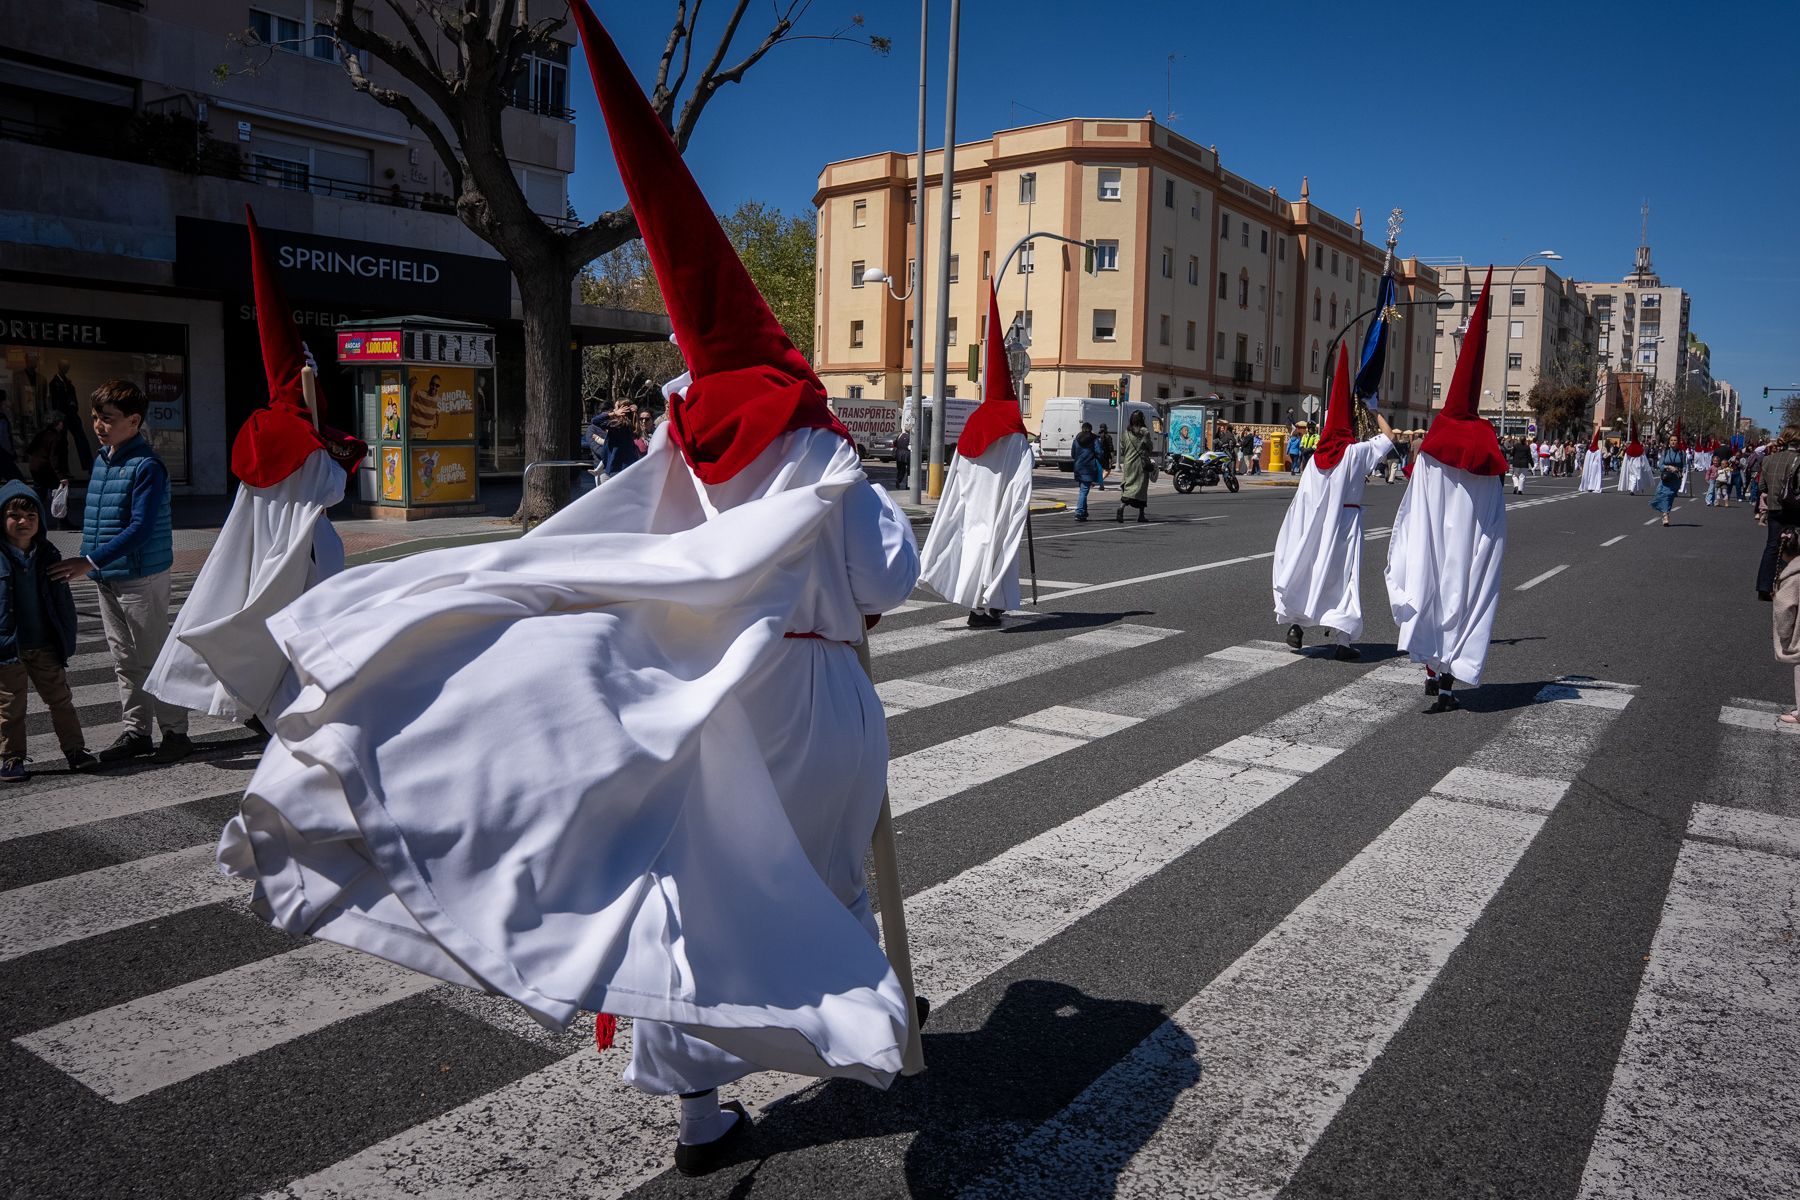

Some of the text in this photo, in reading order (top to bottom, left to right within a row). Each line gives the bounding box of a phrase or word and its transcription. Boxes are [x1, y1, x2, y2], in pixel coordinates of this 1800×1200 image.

[279, 246, 440, 284] SPRINGFIELD
[441, 389, 467, 402] AHORA
[436, 399, 473, 414] SIEMPRE
[838, 407, 897, 420] TRANSPORTES
[440, 463, 462, 474] AHORA
[436, 470, 468, 484] SIEMPRE
